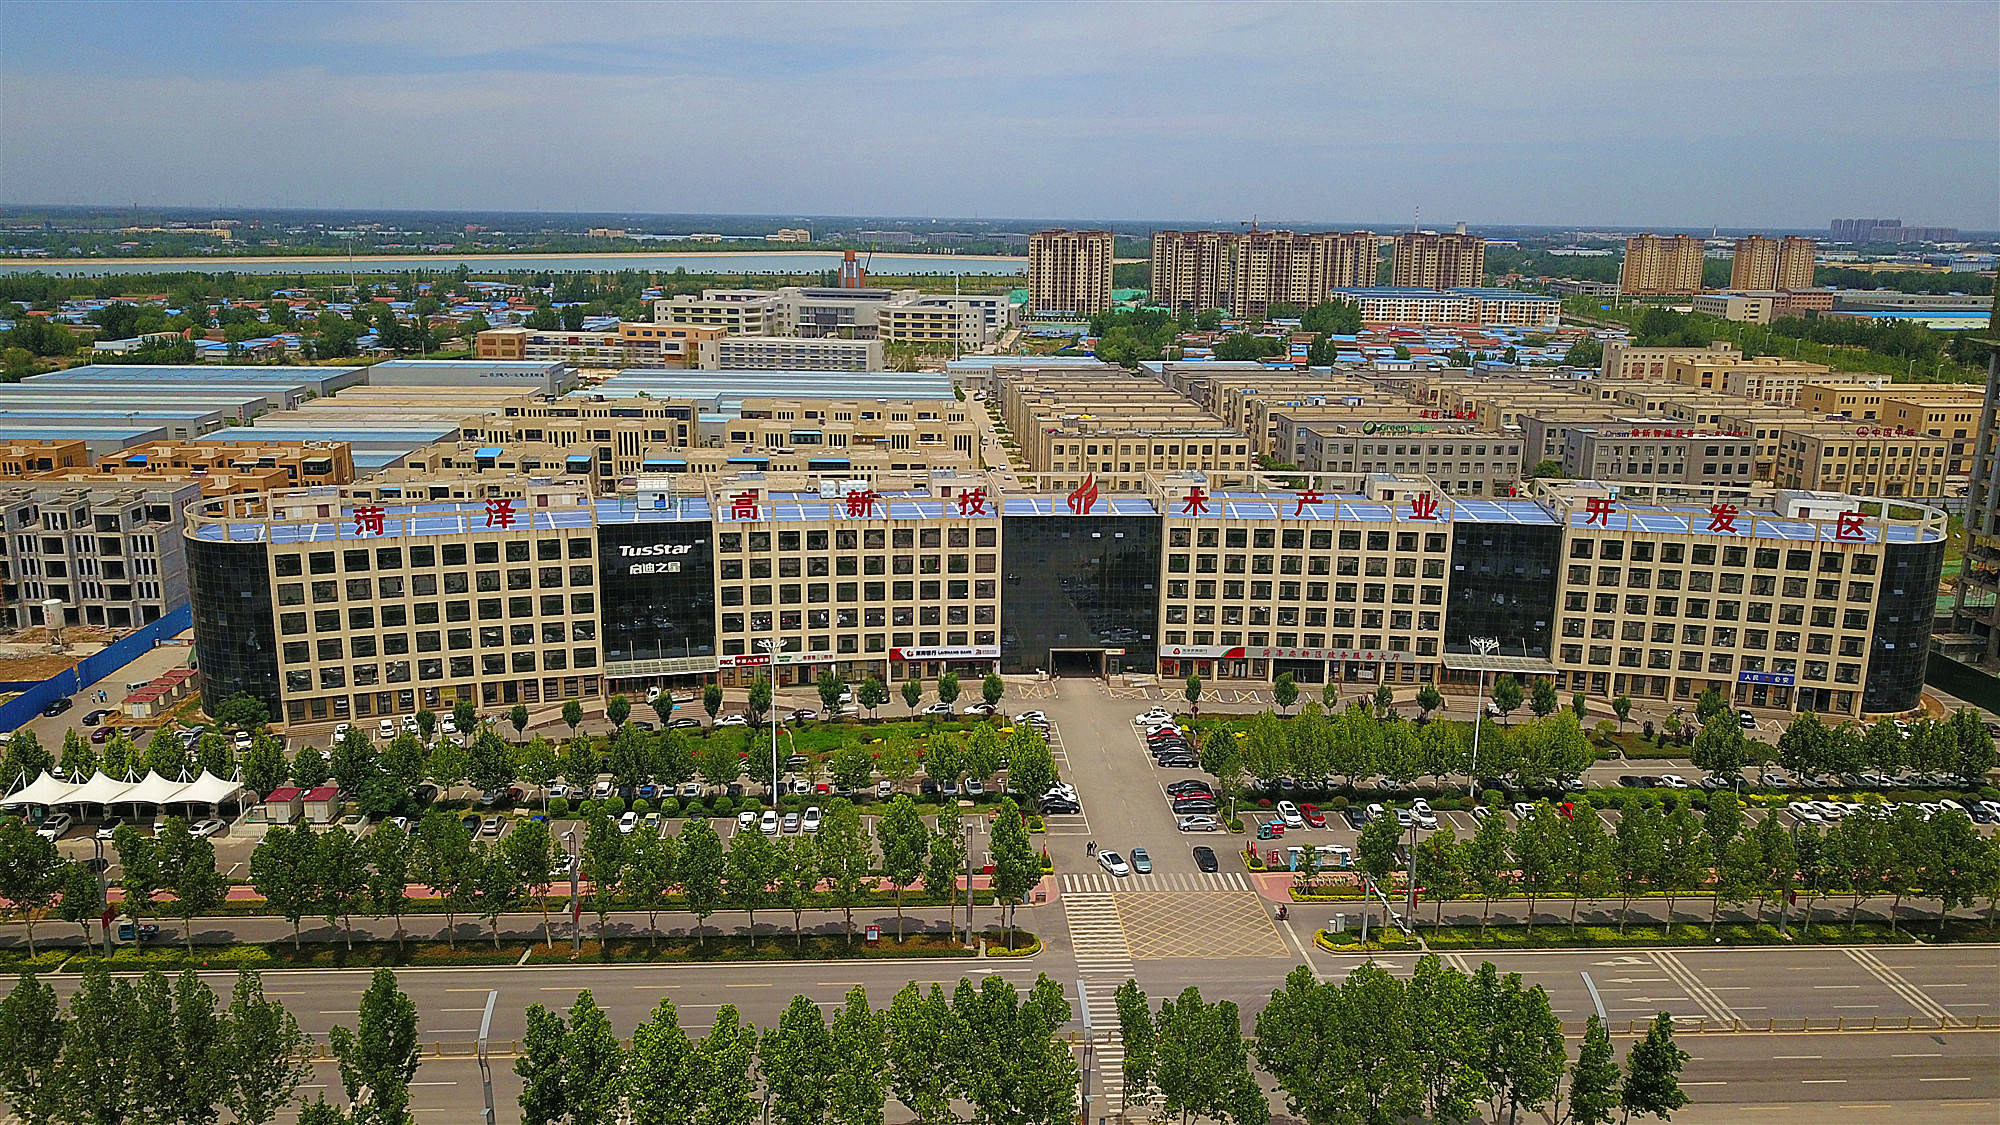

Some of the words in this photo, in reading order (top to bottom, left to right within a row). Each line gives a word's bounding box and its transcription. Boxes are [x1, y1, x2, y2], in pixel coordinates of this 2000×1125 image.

[618, 544, 692, 557] TusStar
[629, 561, 681, 575] 启迪之星
[1774, 676, 1789, 684] 公安
